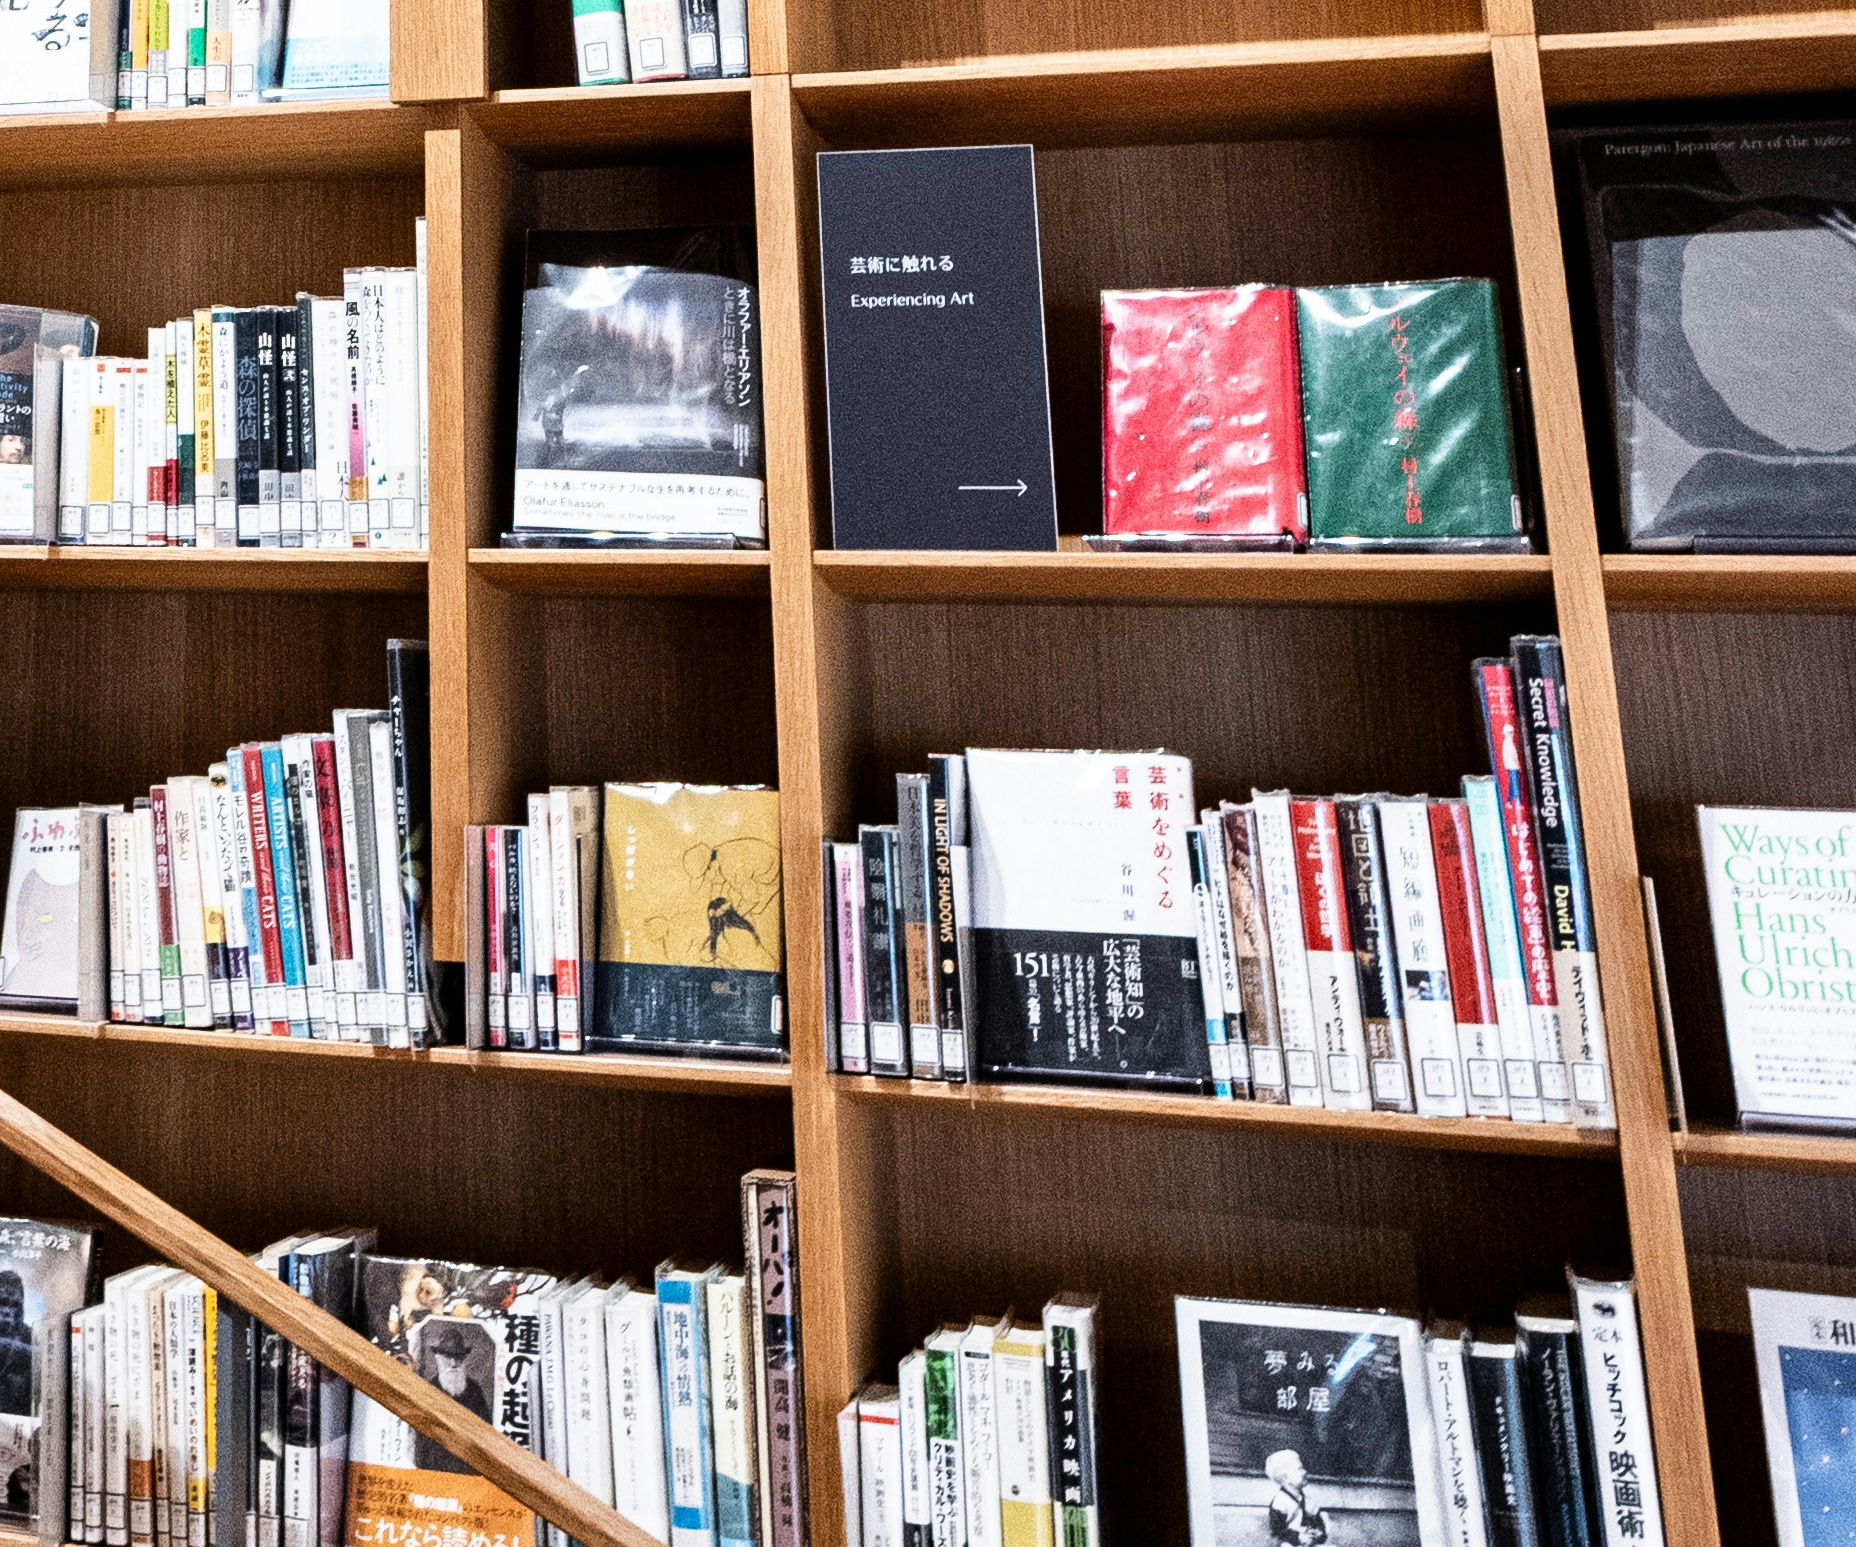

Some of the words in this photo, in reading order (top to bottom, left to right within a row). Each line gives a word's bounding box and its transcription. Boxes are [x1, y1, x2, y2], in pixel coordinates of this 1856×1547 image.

[1675, 139, 1736, 156] Japanese
[1740, 138, 1763, 151] Art
[1767, 135, 1782, 150] of
[1784, 134, 1809, 148] the
[849, 254, 955, 275] 芸術に触れる
[850, 293, 946, 309] Experiencing
[950, 291, 975, 306] Art
[197, 322, 212, 389] 木霊草霊
[258, 332, 274, 367] 山怪
[280, 332, 296, 368] 山怪
[345, 301, 360, 361] 風の名前
[721, 286, 736, 405] ときに川は橋となる
[737, 286, 752, 407] オラファー・エリアソン
[165, 358, 176, 421] 木を植えた人
[237, 356, 258, 442] 森の探偵
[299, 368, 311, 454] センス・オブ・ワンダー
[199, 419, 211, 474] 伊藤比呂美
[523, 496, 557, 508] Olafur
[560, 498, 605, 509] Eliasson
[1528, 676, 1546, 728] Secret
[934, 798, 947, 813] IN
[1112, 764, 1133, 811] 言葉
[1536, 733, 1559, 829] Knowledge
[249, 789, 270, 850] WRITERS
[260, 895, 277, 929] CATS
[935, 815, 948, 853] LIGHT
[1147, 765, 1174, 910] 芸術をめぐる
[1720, 824, 1811, 865] Ways
[1816, 824, 1851, 858] of
[271, 795, 289, 851] ARTISTS
[280, 895, 297, 929] CATS
[936, 857, 950, 874] OF
[937, 876, 954, 943] SHADOWS
[1554, 884, 1575, 935] David
[1733, 901, 1827, 935] Hans
[1013, 951, 1051, 978] 151
[1737, 933, 1855, 969] Ulrich
[1102, 937, 1127, 1035] 広大な地平へ
[1121, 937, 1145, 1020] 「芸術知」の
[1741, 966, 1856, 1003] Obrist
[579, 1315, 592, 1422] タコの心身問題
[1263, 1349, 1340, 1376] 夢みる
[1276, 1385, 1331, 1412] 部屋
[1602, 1352, 1627, 1445] ヒッチコック
[1058, 1367, 1082, 1504] アメリカ映画
[1608, 1450, 1645, 1540] 映画術
